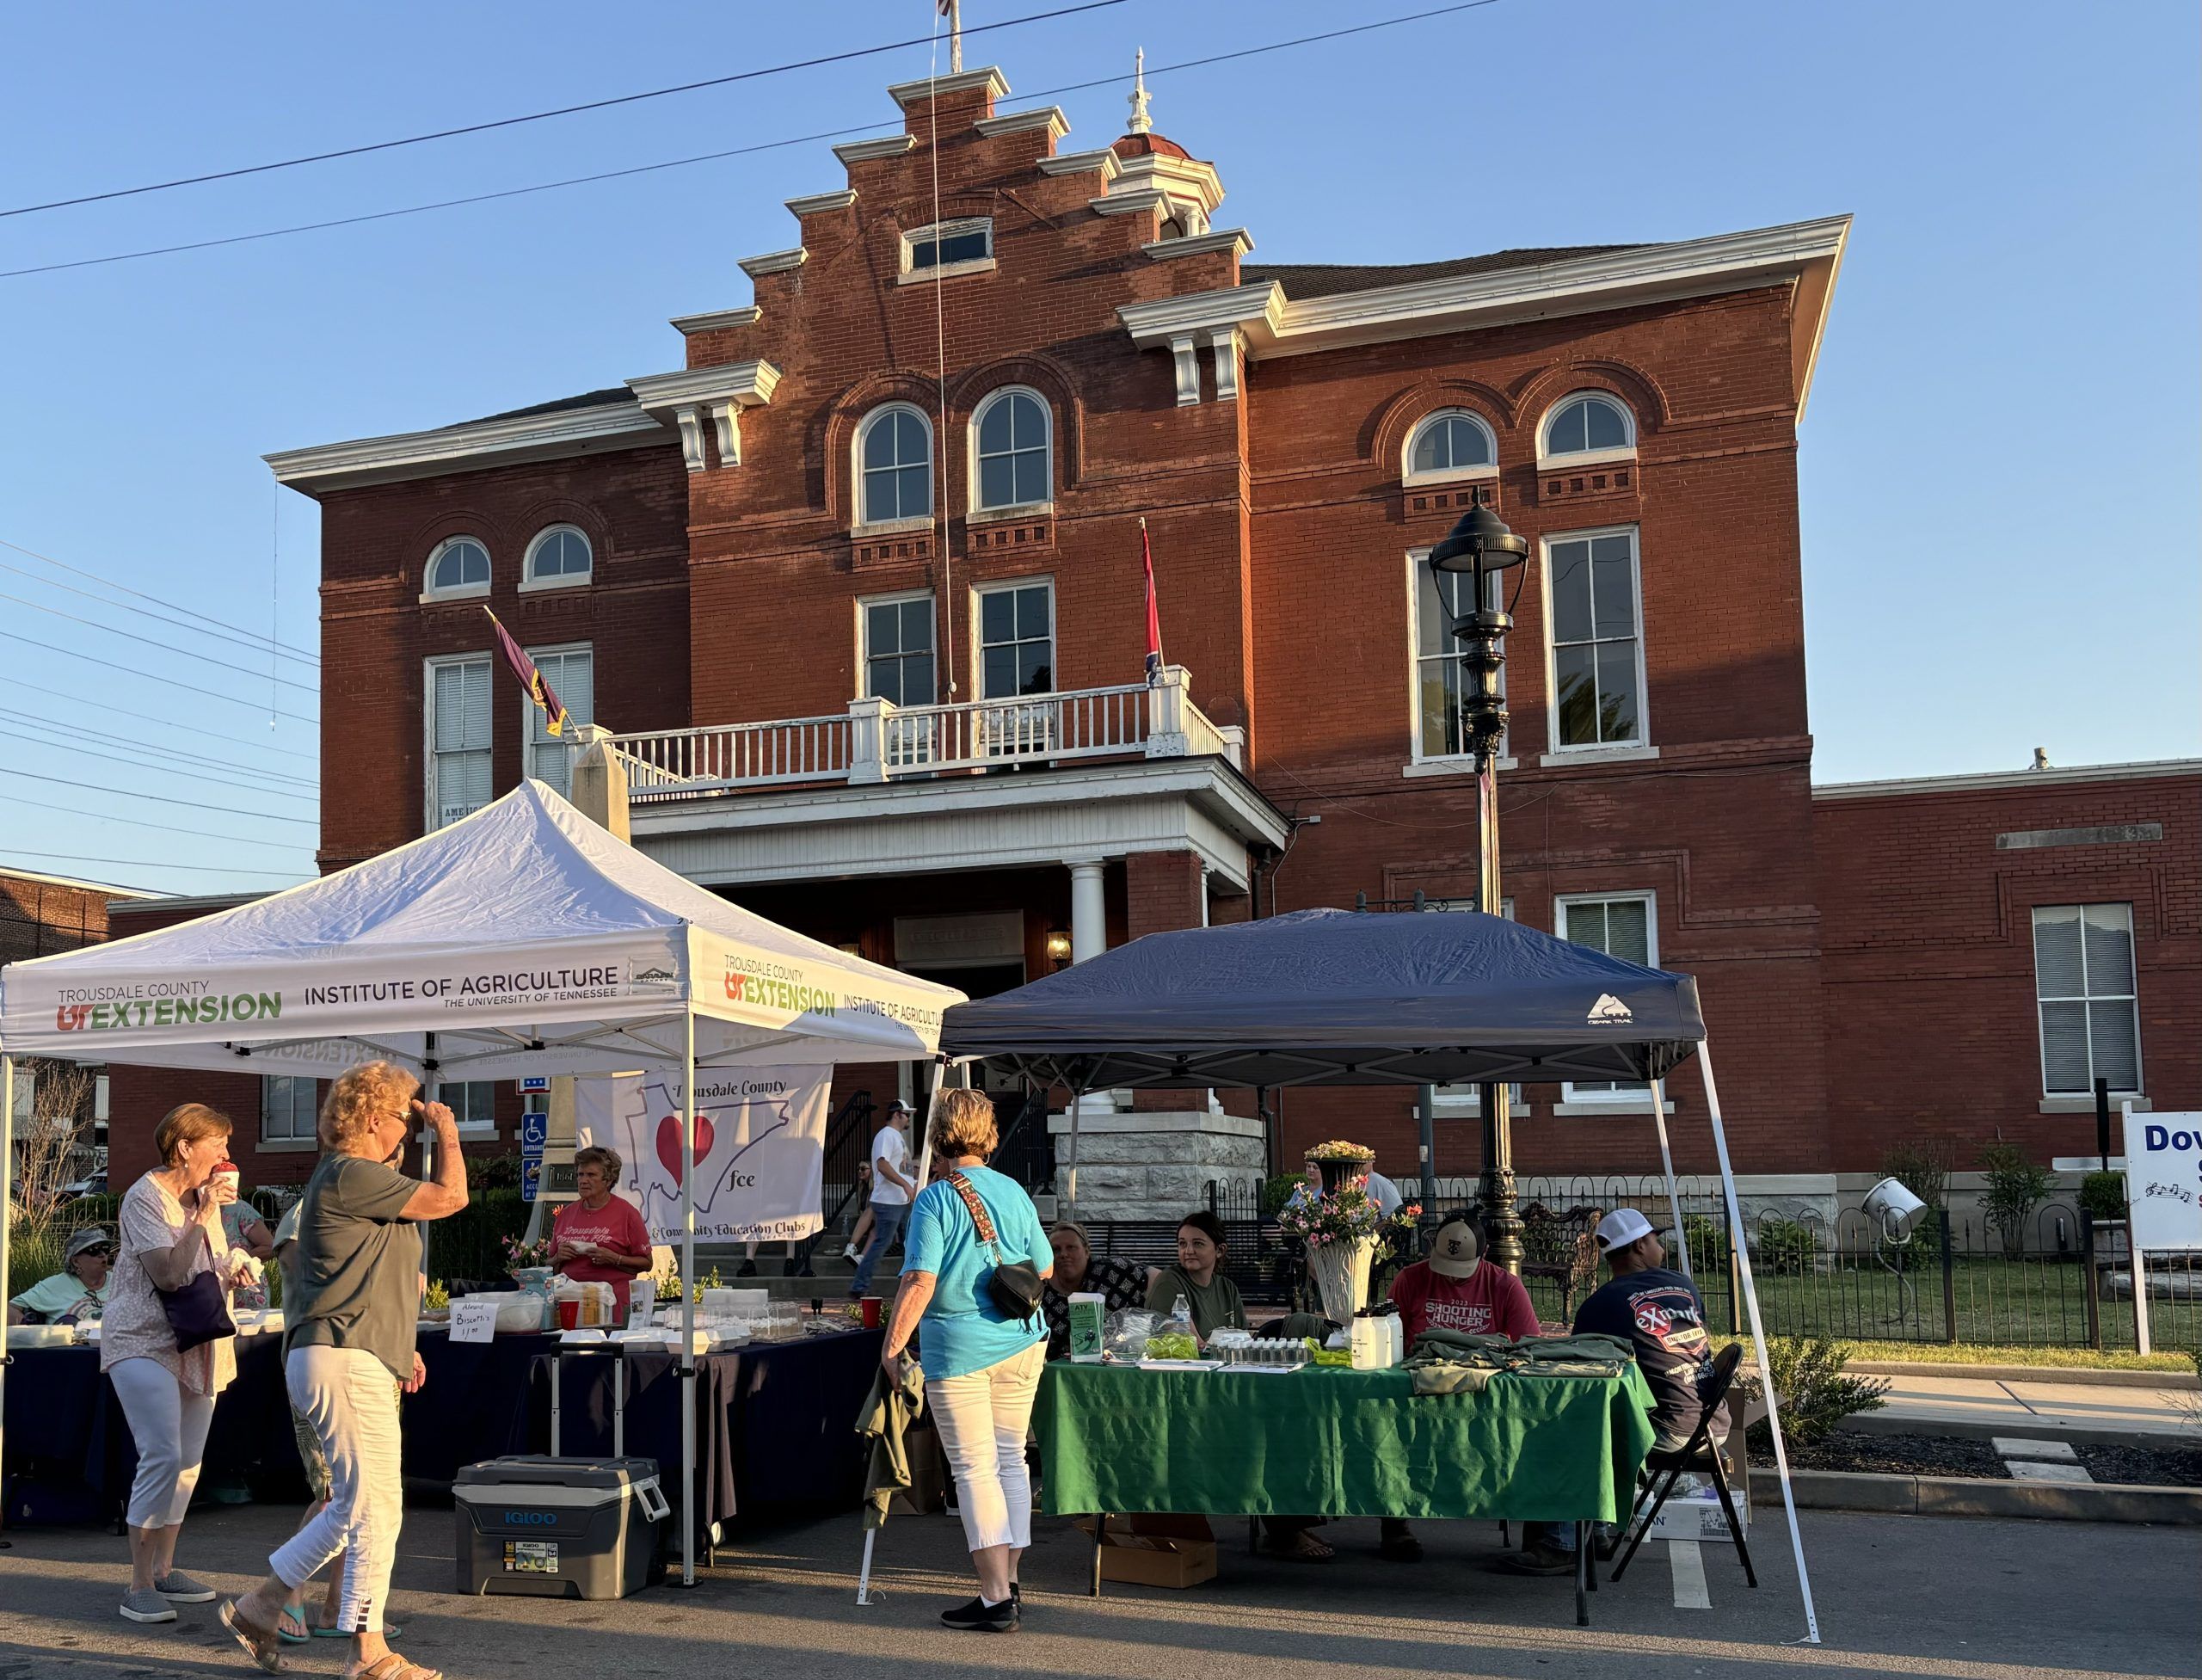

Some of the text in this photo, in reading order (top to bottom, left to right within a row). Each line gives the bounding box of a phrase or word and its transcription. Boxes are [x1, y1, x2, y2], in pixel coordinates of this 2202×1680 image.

[724, 954, 803, 982] TROUSDALE COUNTY
[58, 980, 209, 1003] TROUSDALE COUNTY
[304, 966, 618, 1006] INSTITUTE OF AGRICULTURE
[444, 987, 618, 1008] THE UNIVERSITY OF TENNESSEE
[844, 994, 886, 1017] INSTITUTE
[888, 1002, 899, 1018] OF
[741, 1080, 787, 1095] County
[725, 1170, 755, 1192] fce
[563, 1226, 610, 1234] Trousdale
[651, 1228, 660, 1239] &
[714, 1223, 772, 1236] Education
[775, 1222, 806, 1234] Clubs
[1425, 1302, 1492, 1319] SHOOTING
[1451, 1298, 1468, 1307] 2023
[1432, 1313, 1484, 1326] HUNGER
[504, 1512, 557, 1524] IGLOO
